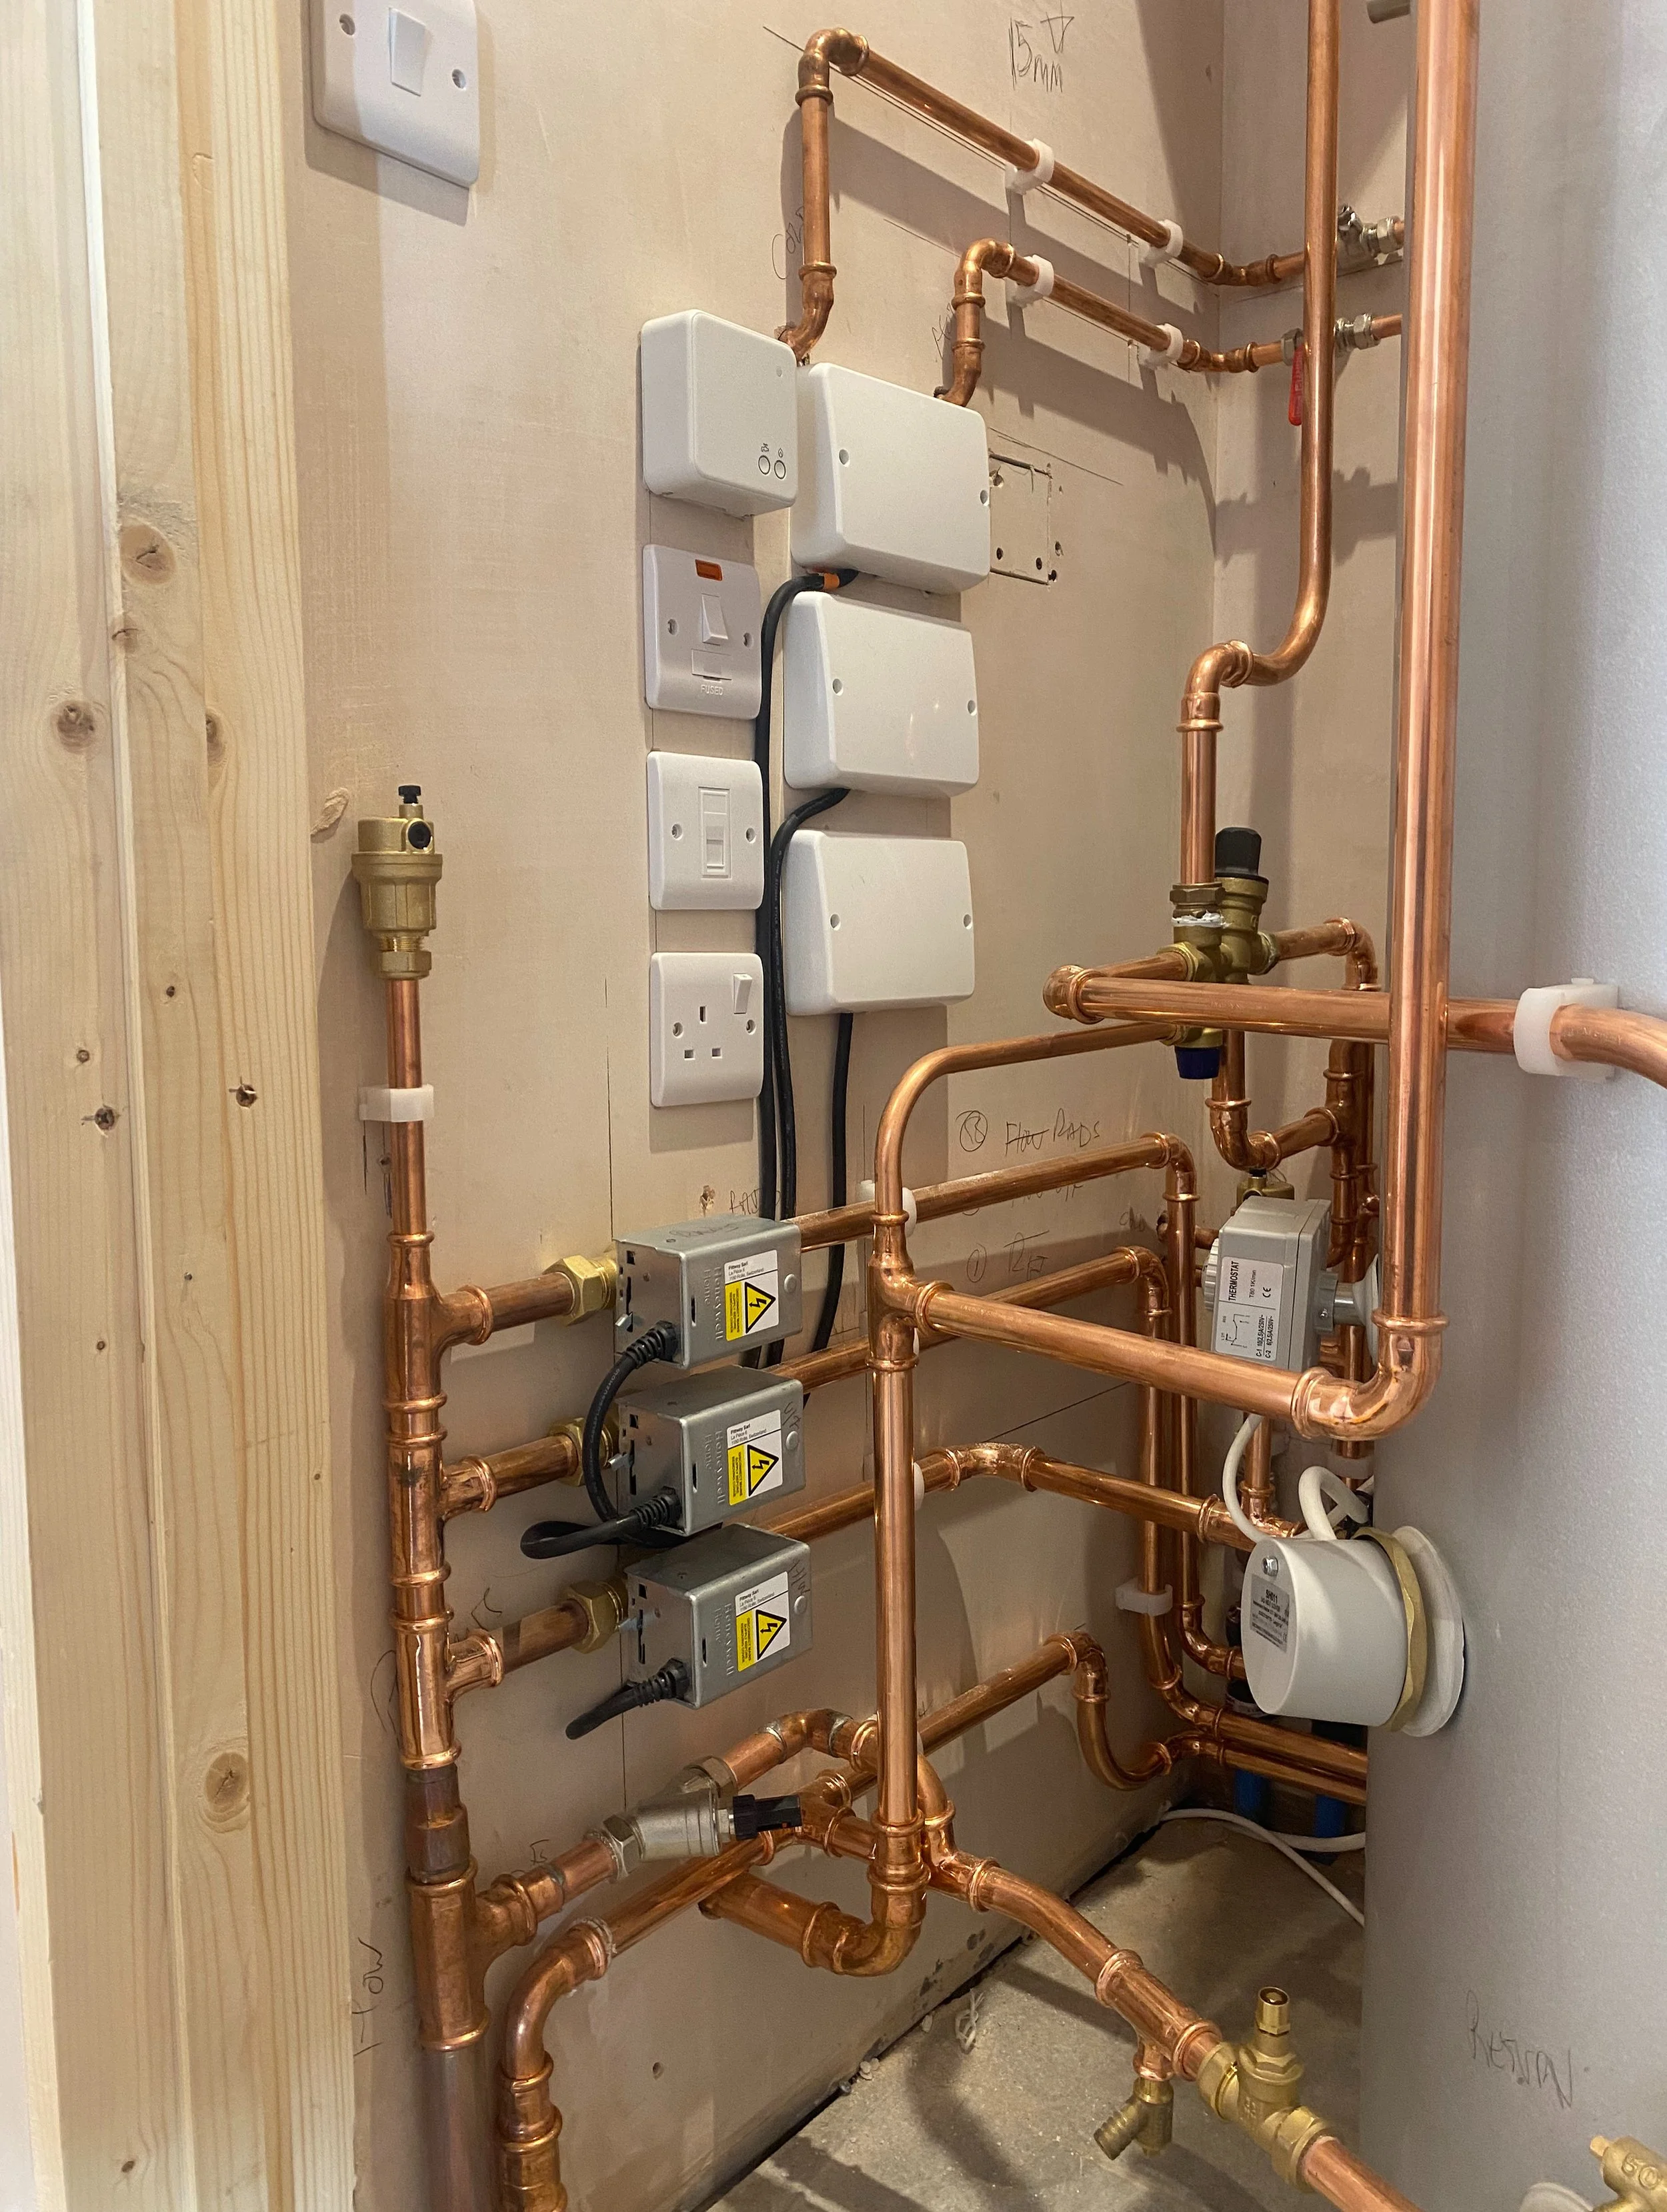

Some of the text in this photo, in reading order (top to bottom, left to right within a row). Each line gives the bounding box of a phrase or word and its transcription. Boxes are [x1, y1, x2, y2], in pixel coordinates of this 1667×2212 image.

[701, 684, 723, 696] FUSED
[713, 1266, 723, 1340] Honeywell
[1228, 1261, 1239, 1301] THERMOSTAT
[715, 1430, 725, 1504] Honeywell
